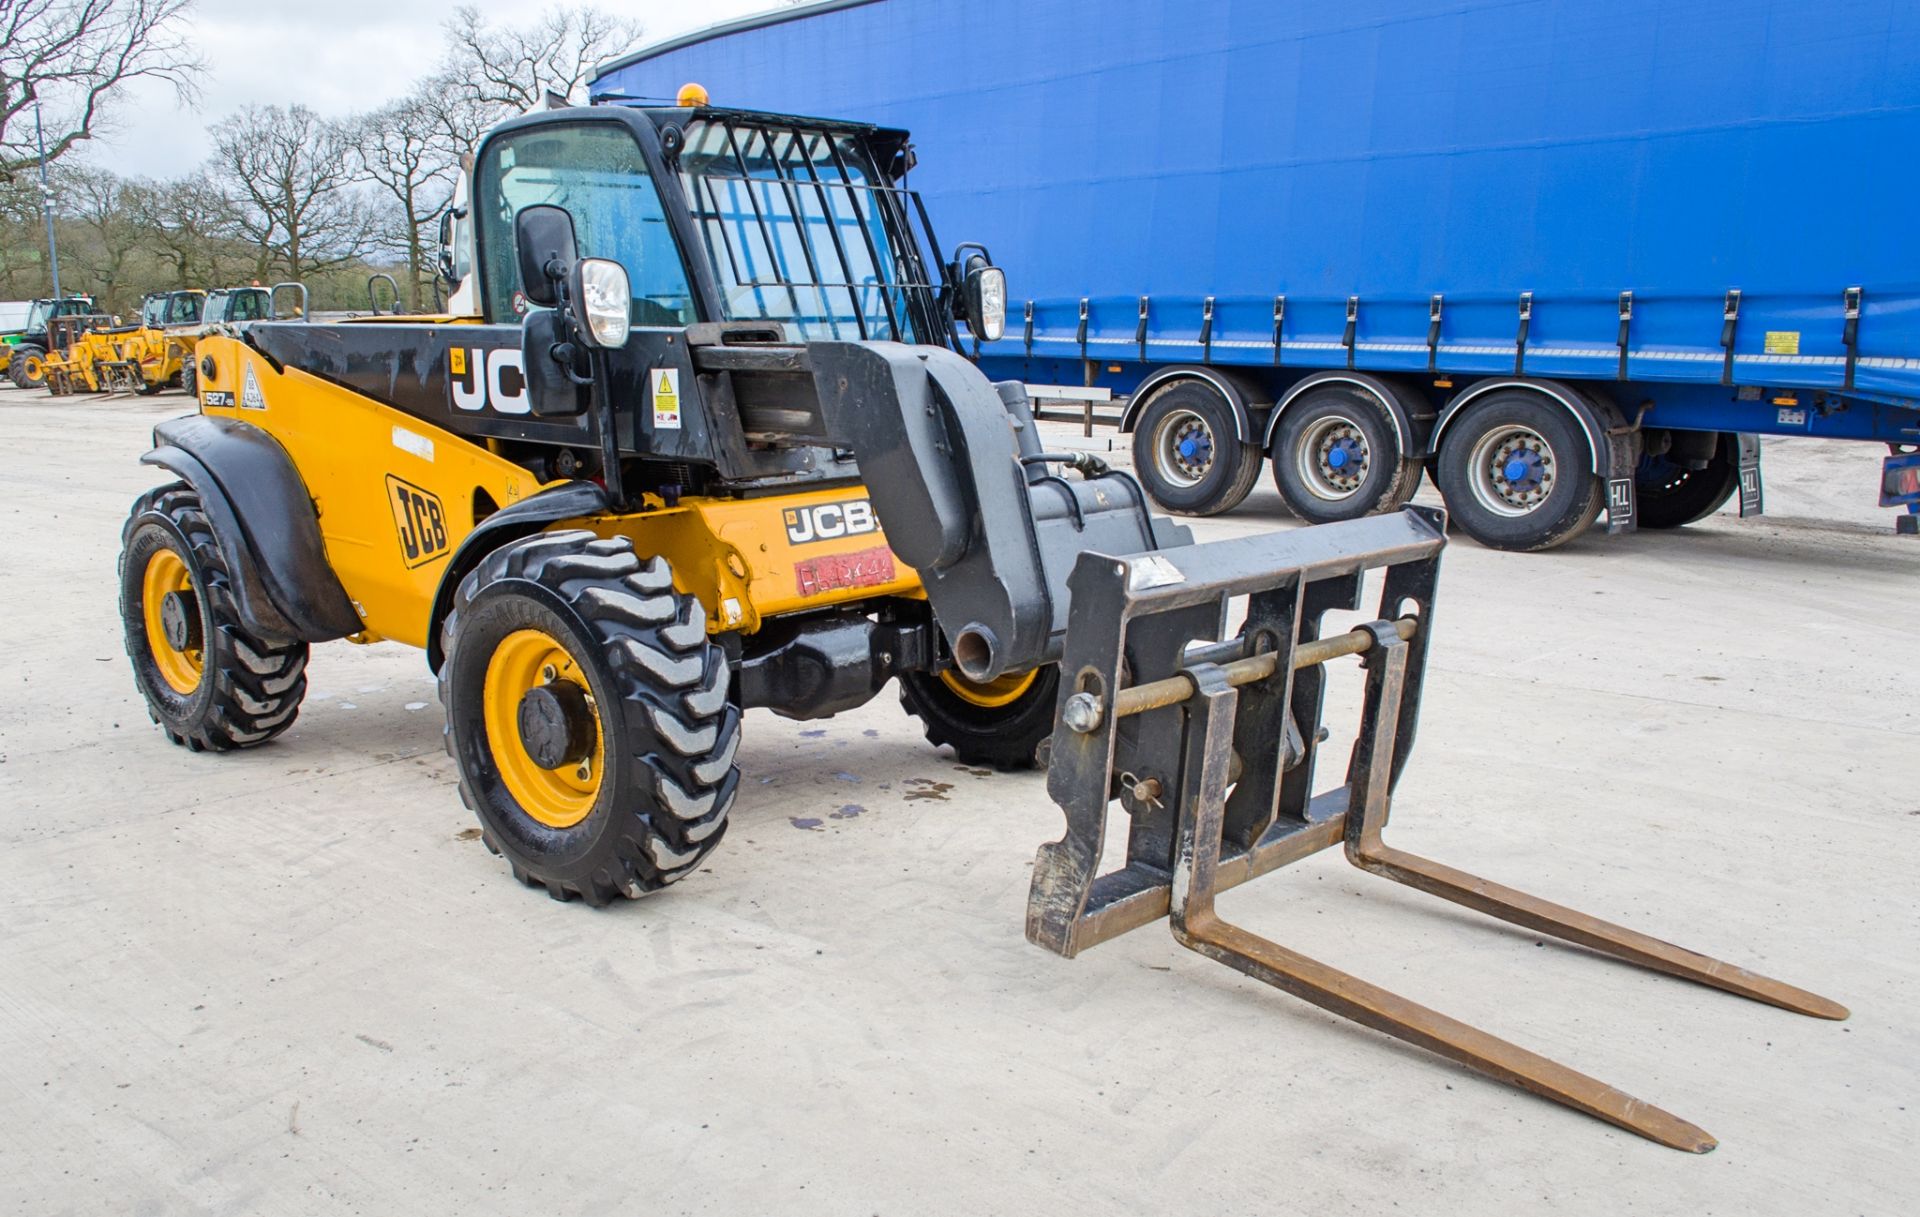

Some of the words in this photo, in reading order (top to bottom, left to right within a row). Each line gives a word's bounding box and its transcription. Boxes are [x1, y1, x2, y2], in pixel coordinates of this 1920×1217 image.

[452, 348, 530, 414] JC
[396, 485, 446, 560] JCB
[788, 501, 875, 542] JCB
